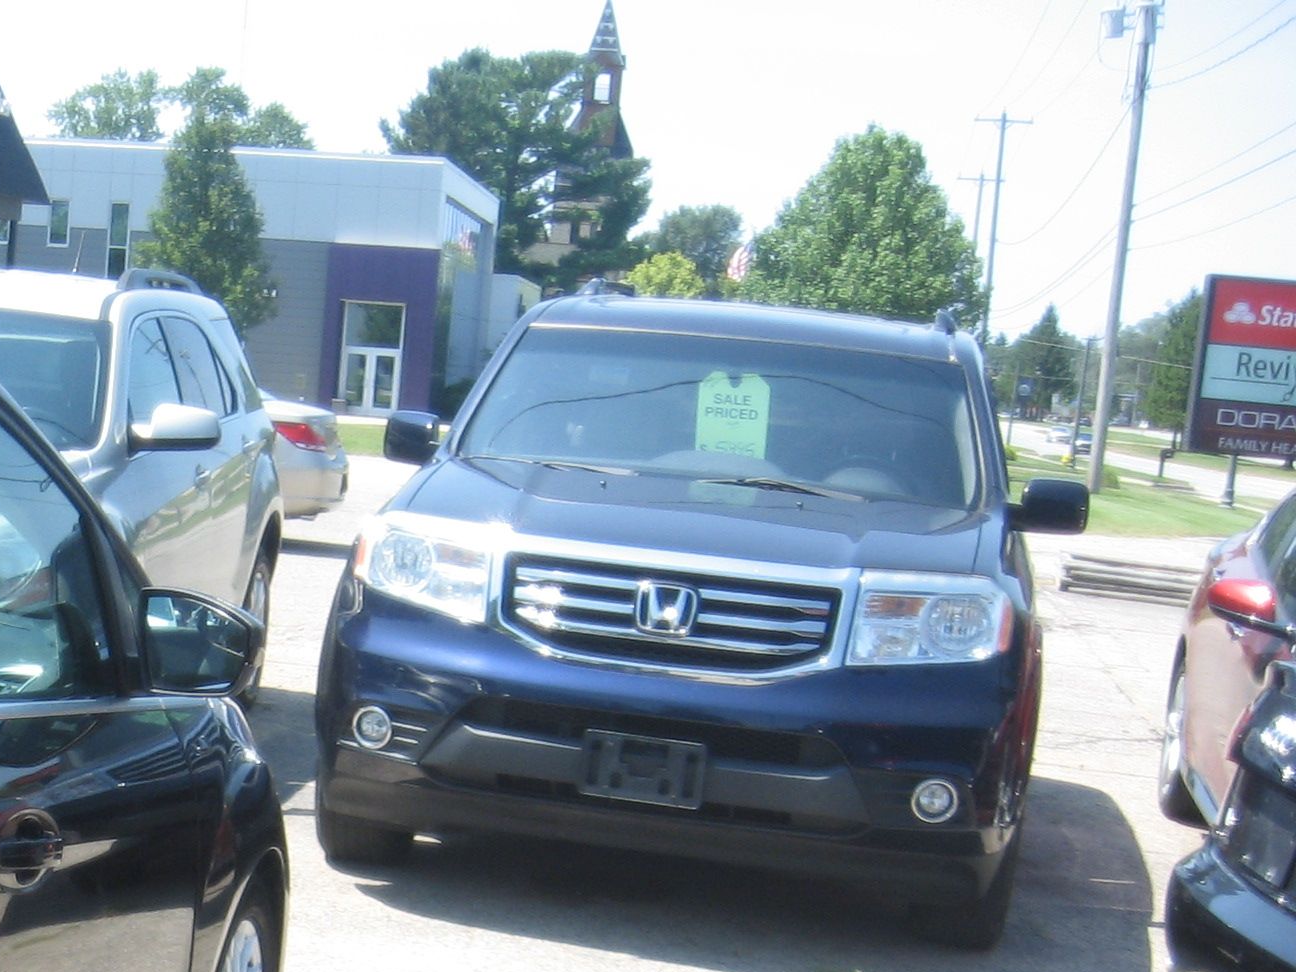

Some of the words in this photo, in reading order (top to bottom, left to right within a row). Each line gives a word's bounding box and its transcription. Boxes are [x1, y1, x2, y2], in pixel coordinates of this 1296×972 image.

[1258, 304, 1296, 328] Sta
[1235, 352, 1296, 381] Revi
[713, 393, 753, 406] SALE
[705, 406, 759, 420] PRICED
[1218, 437, 1268, 452] FAMILY
